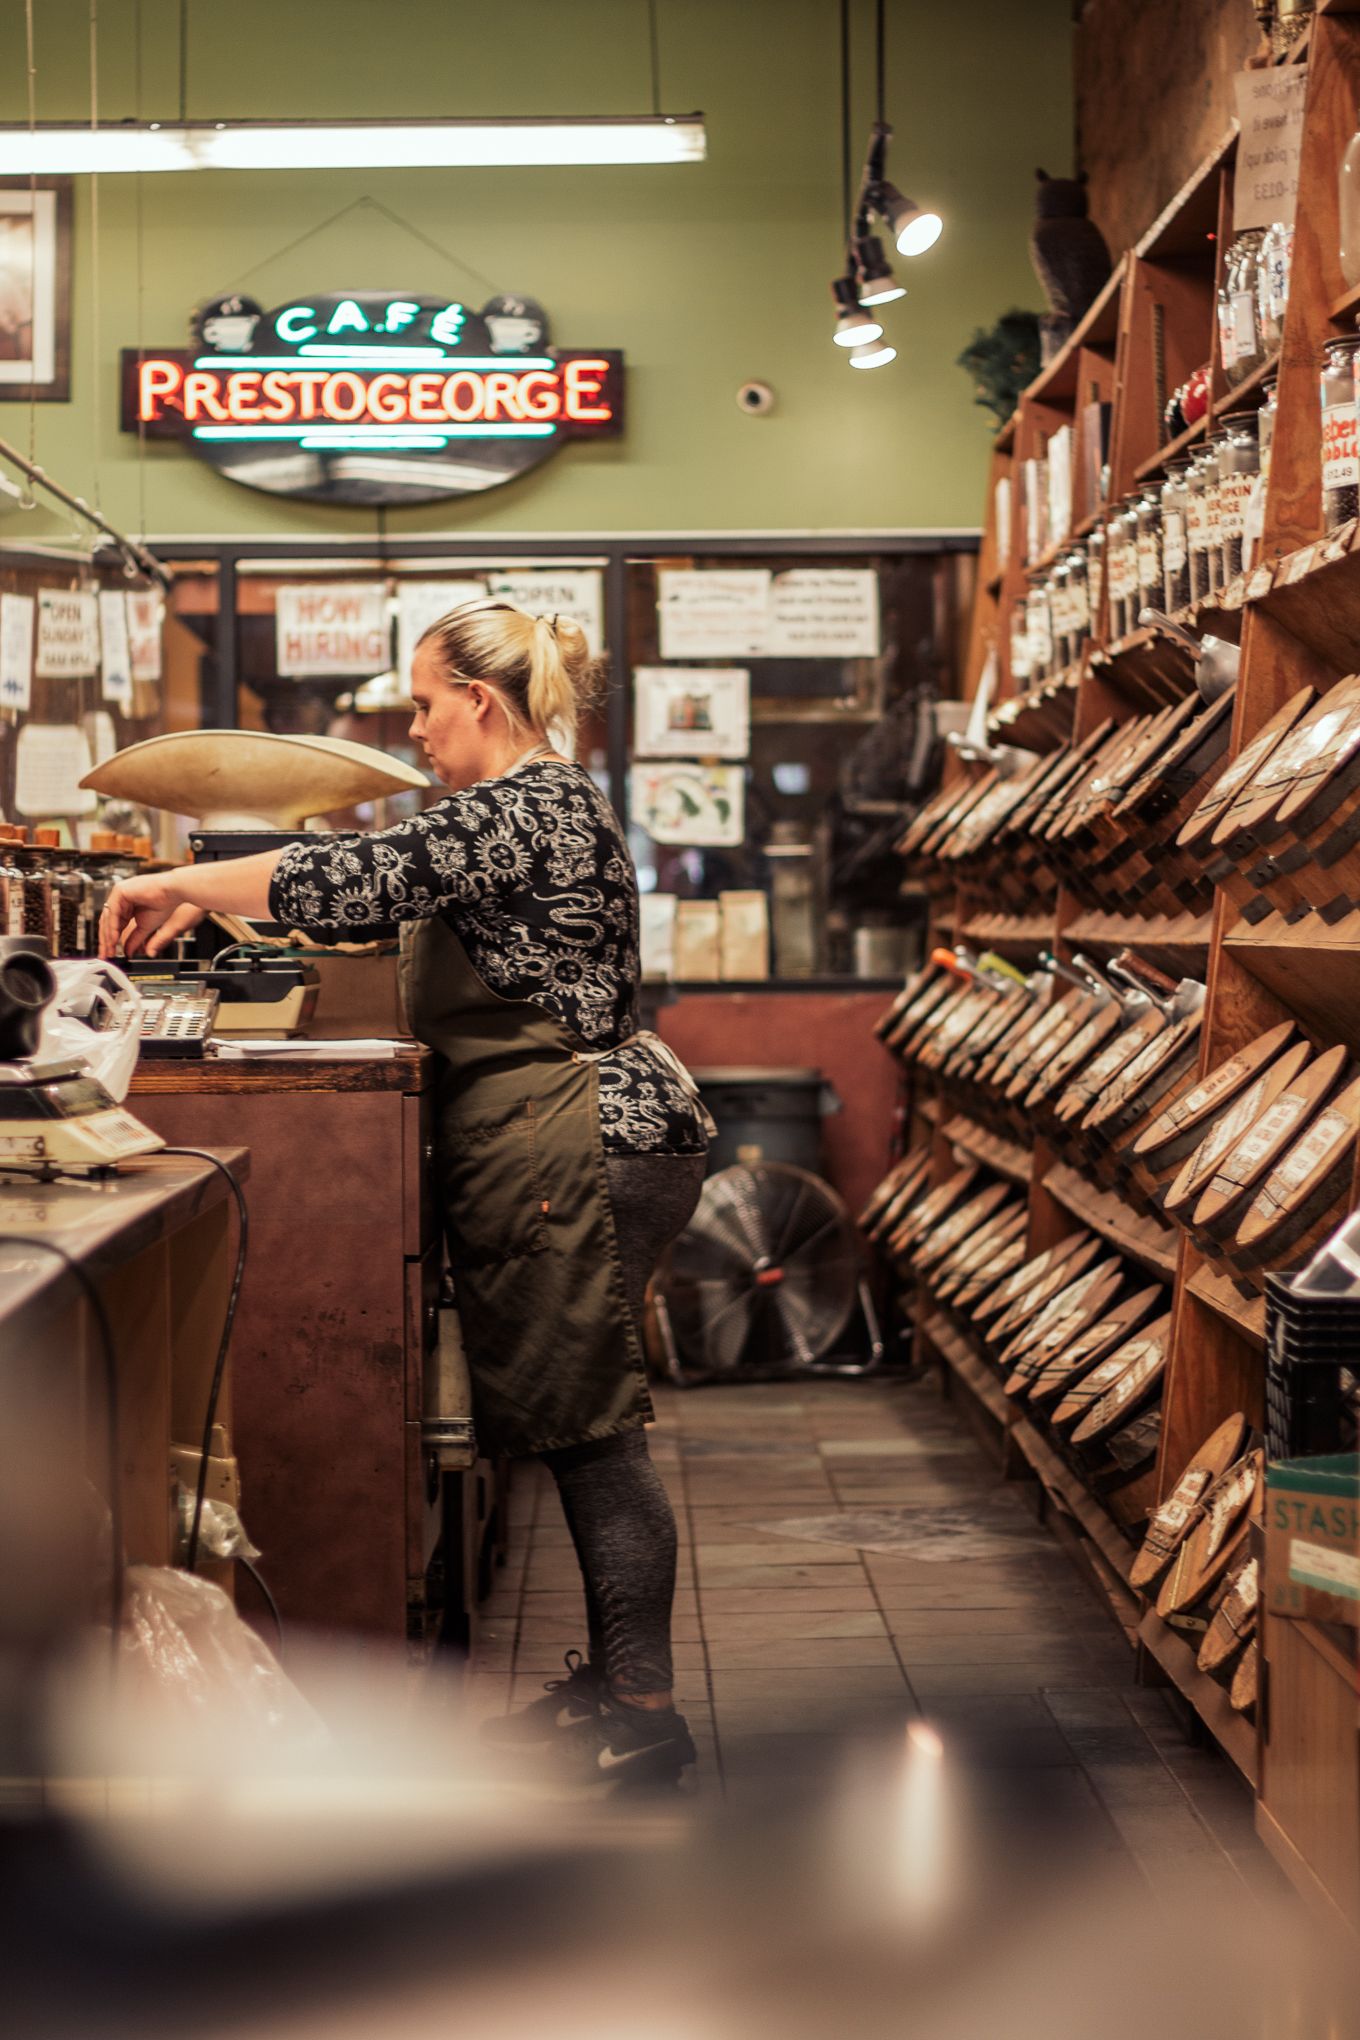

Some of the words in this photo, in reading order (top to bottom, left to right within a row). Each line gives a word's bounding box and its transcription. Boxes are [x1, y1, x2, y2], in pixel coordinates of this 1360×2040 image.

[138, 359, 612, 422] PRESTOGEORGE
[513, 585, 575, 604] OPEN
[286, 629, 382, 662] HIRING
